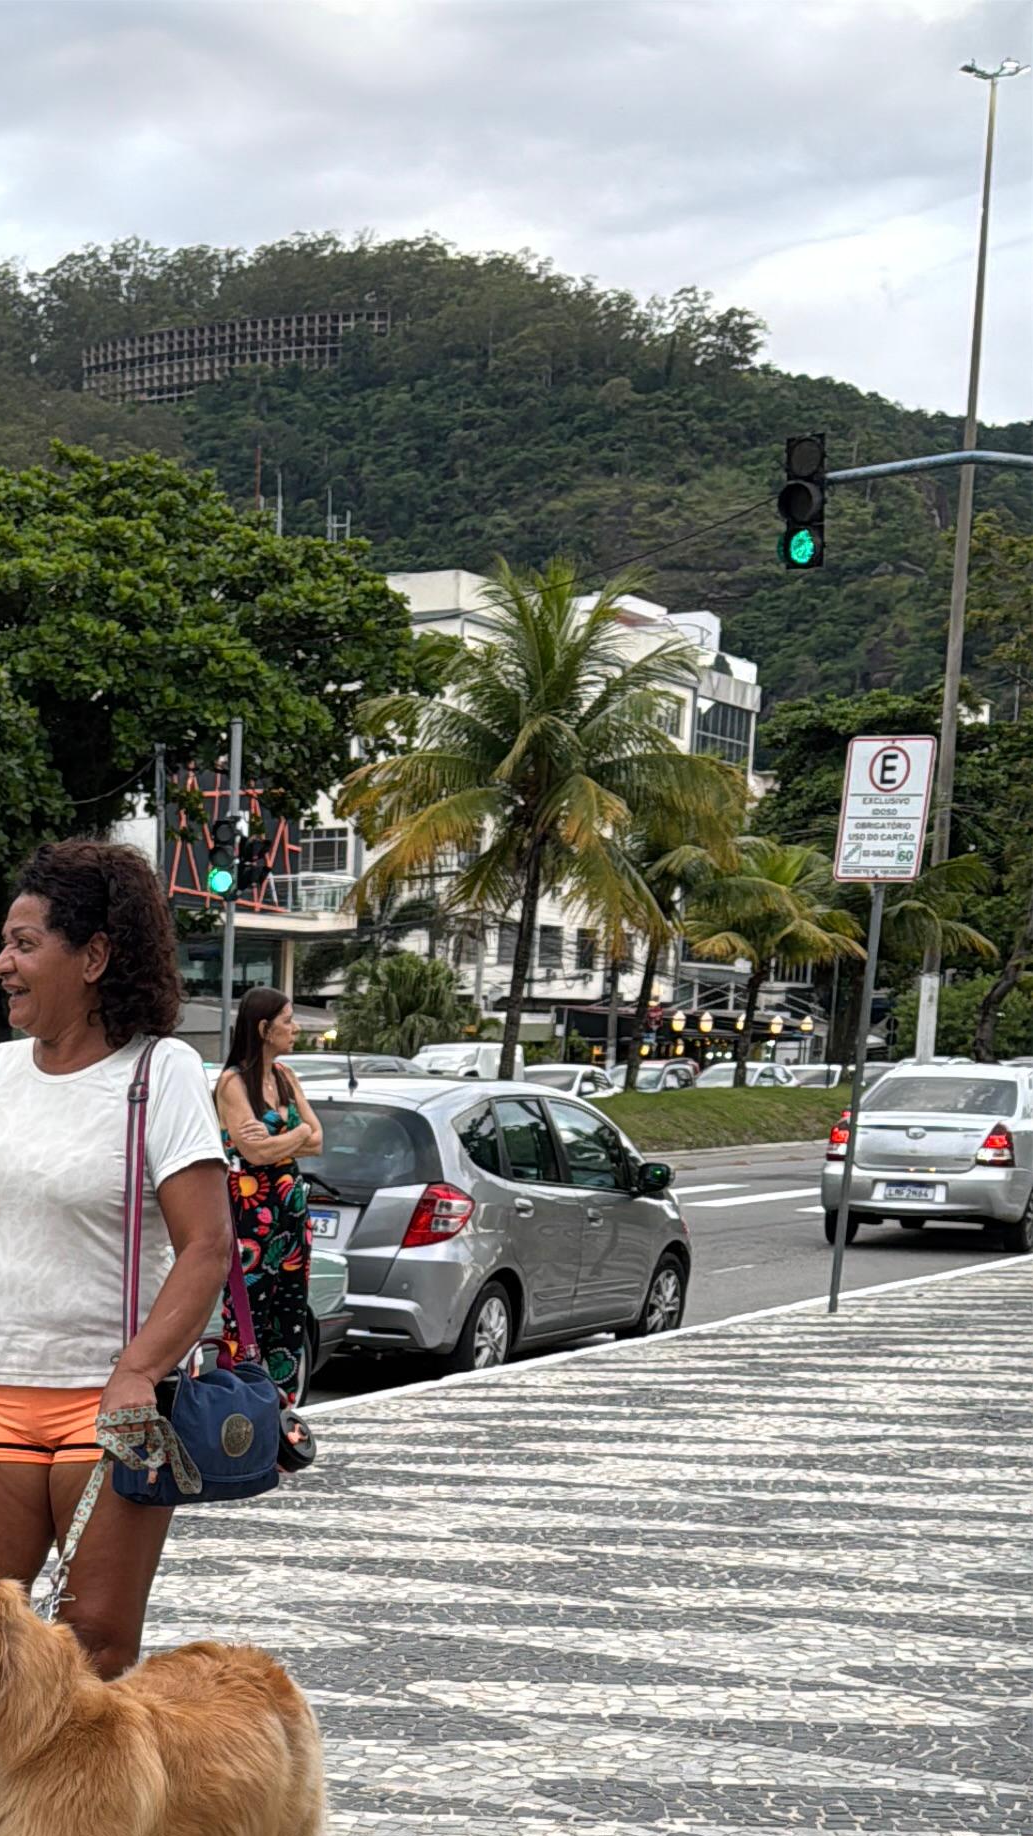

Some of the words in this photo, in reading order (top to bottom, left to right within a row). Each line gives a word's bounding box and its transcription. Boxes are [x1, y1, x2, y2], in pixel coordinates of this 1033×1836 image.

[880, 754, 899, 784] E
[862, 797, 911, 805] EXCLUSIVO
[854, 821, 911, 829] OBRIGATÓRIO
[848, 833, 866, 841] USO
[867, 833, 879, 841] DO
[880, 831, 916, 841] CARTÃO
[897, 850, 914, 862] 60
